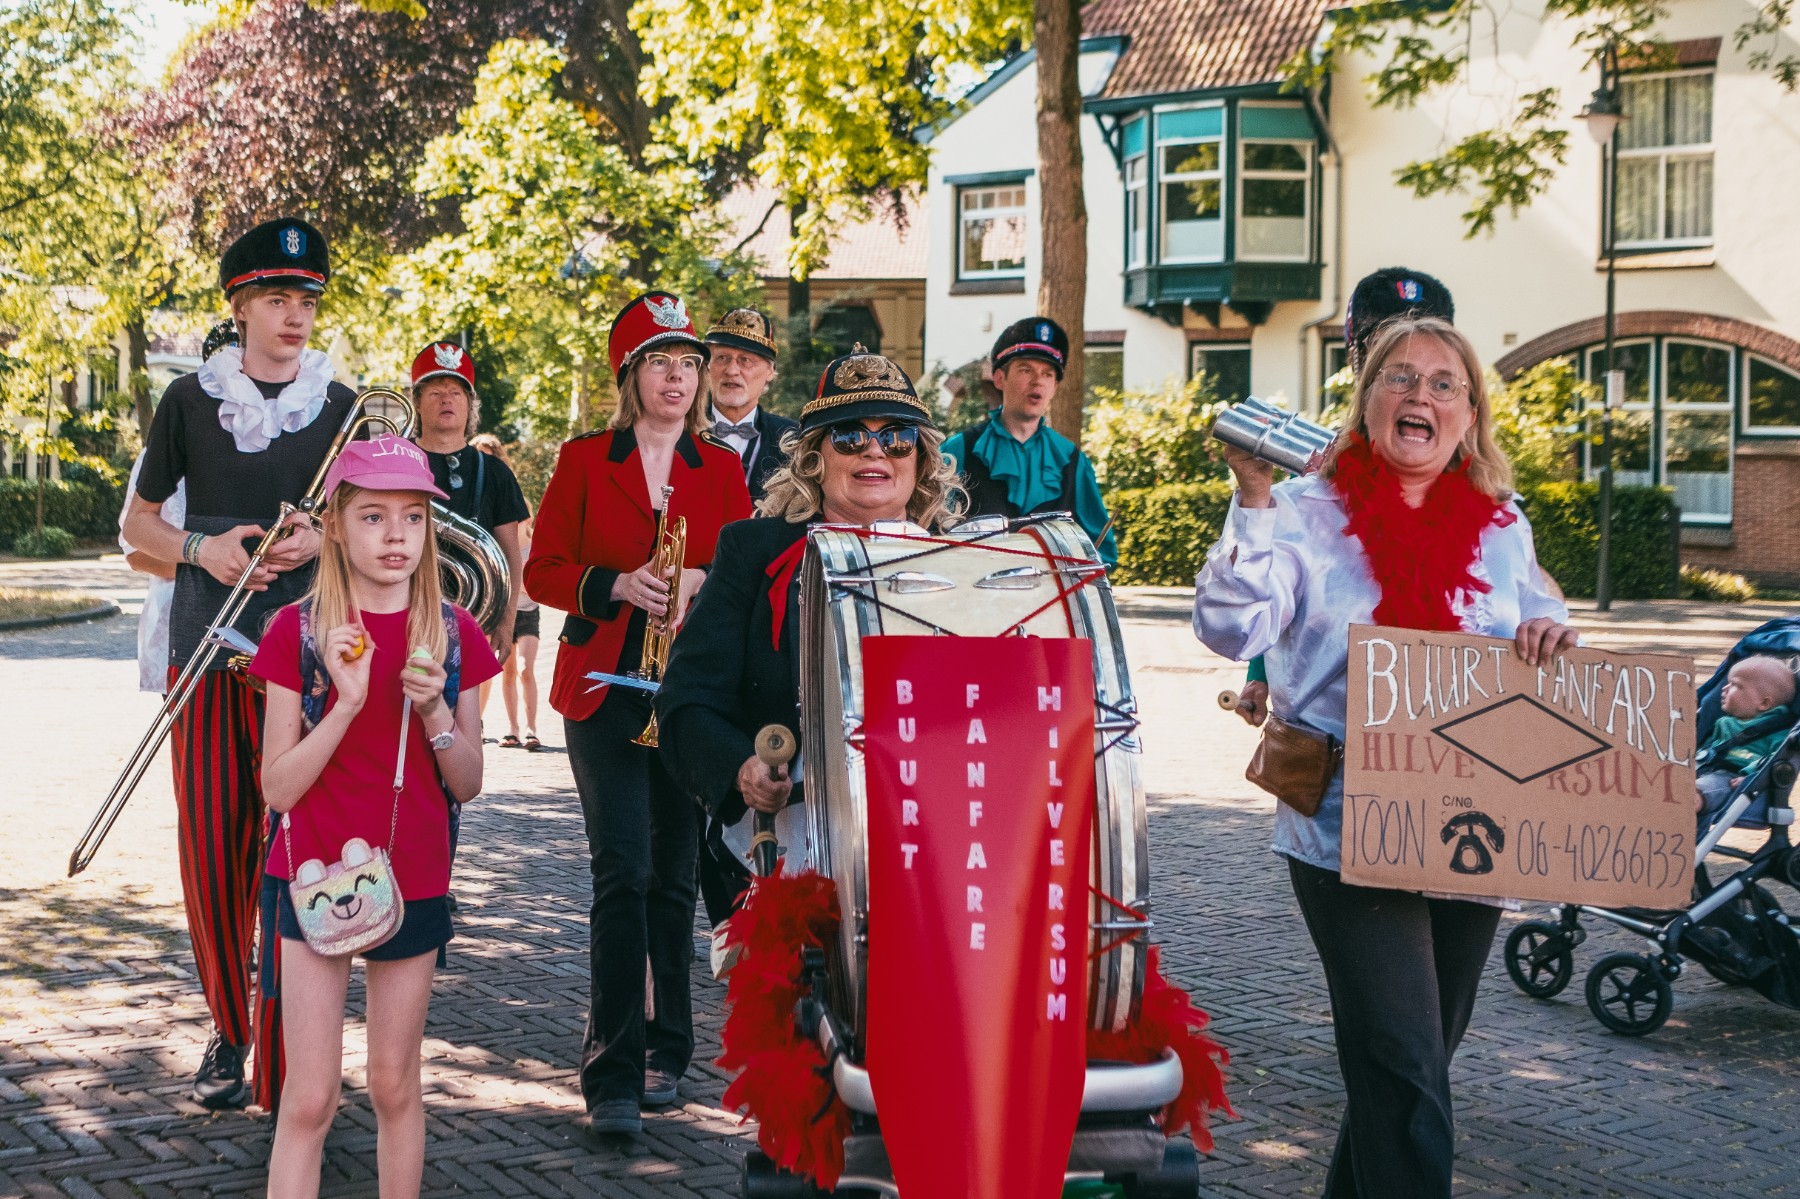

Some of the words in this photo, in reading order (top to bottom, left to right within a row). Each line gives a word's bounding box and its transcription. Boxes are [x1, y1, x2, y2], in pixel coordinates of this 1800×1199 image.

[896, 679, 918, 869] BUURT
[1358, 638, 1508, 727] BUURT
[1536, 655, 1692, 767] FANFARE
[966, 684, 987, 951] FANFARE
[1037, 686, 1066, 1022] HILVERSUM
[1346, 794, 1425, 868] TOON
[1516, 819, 1687, 890] 06-40266133
